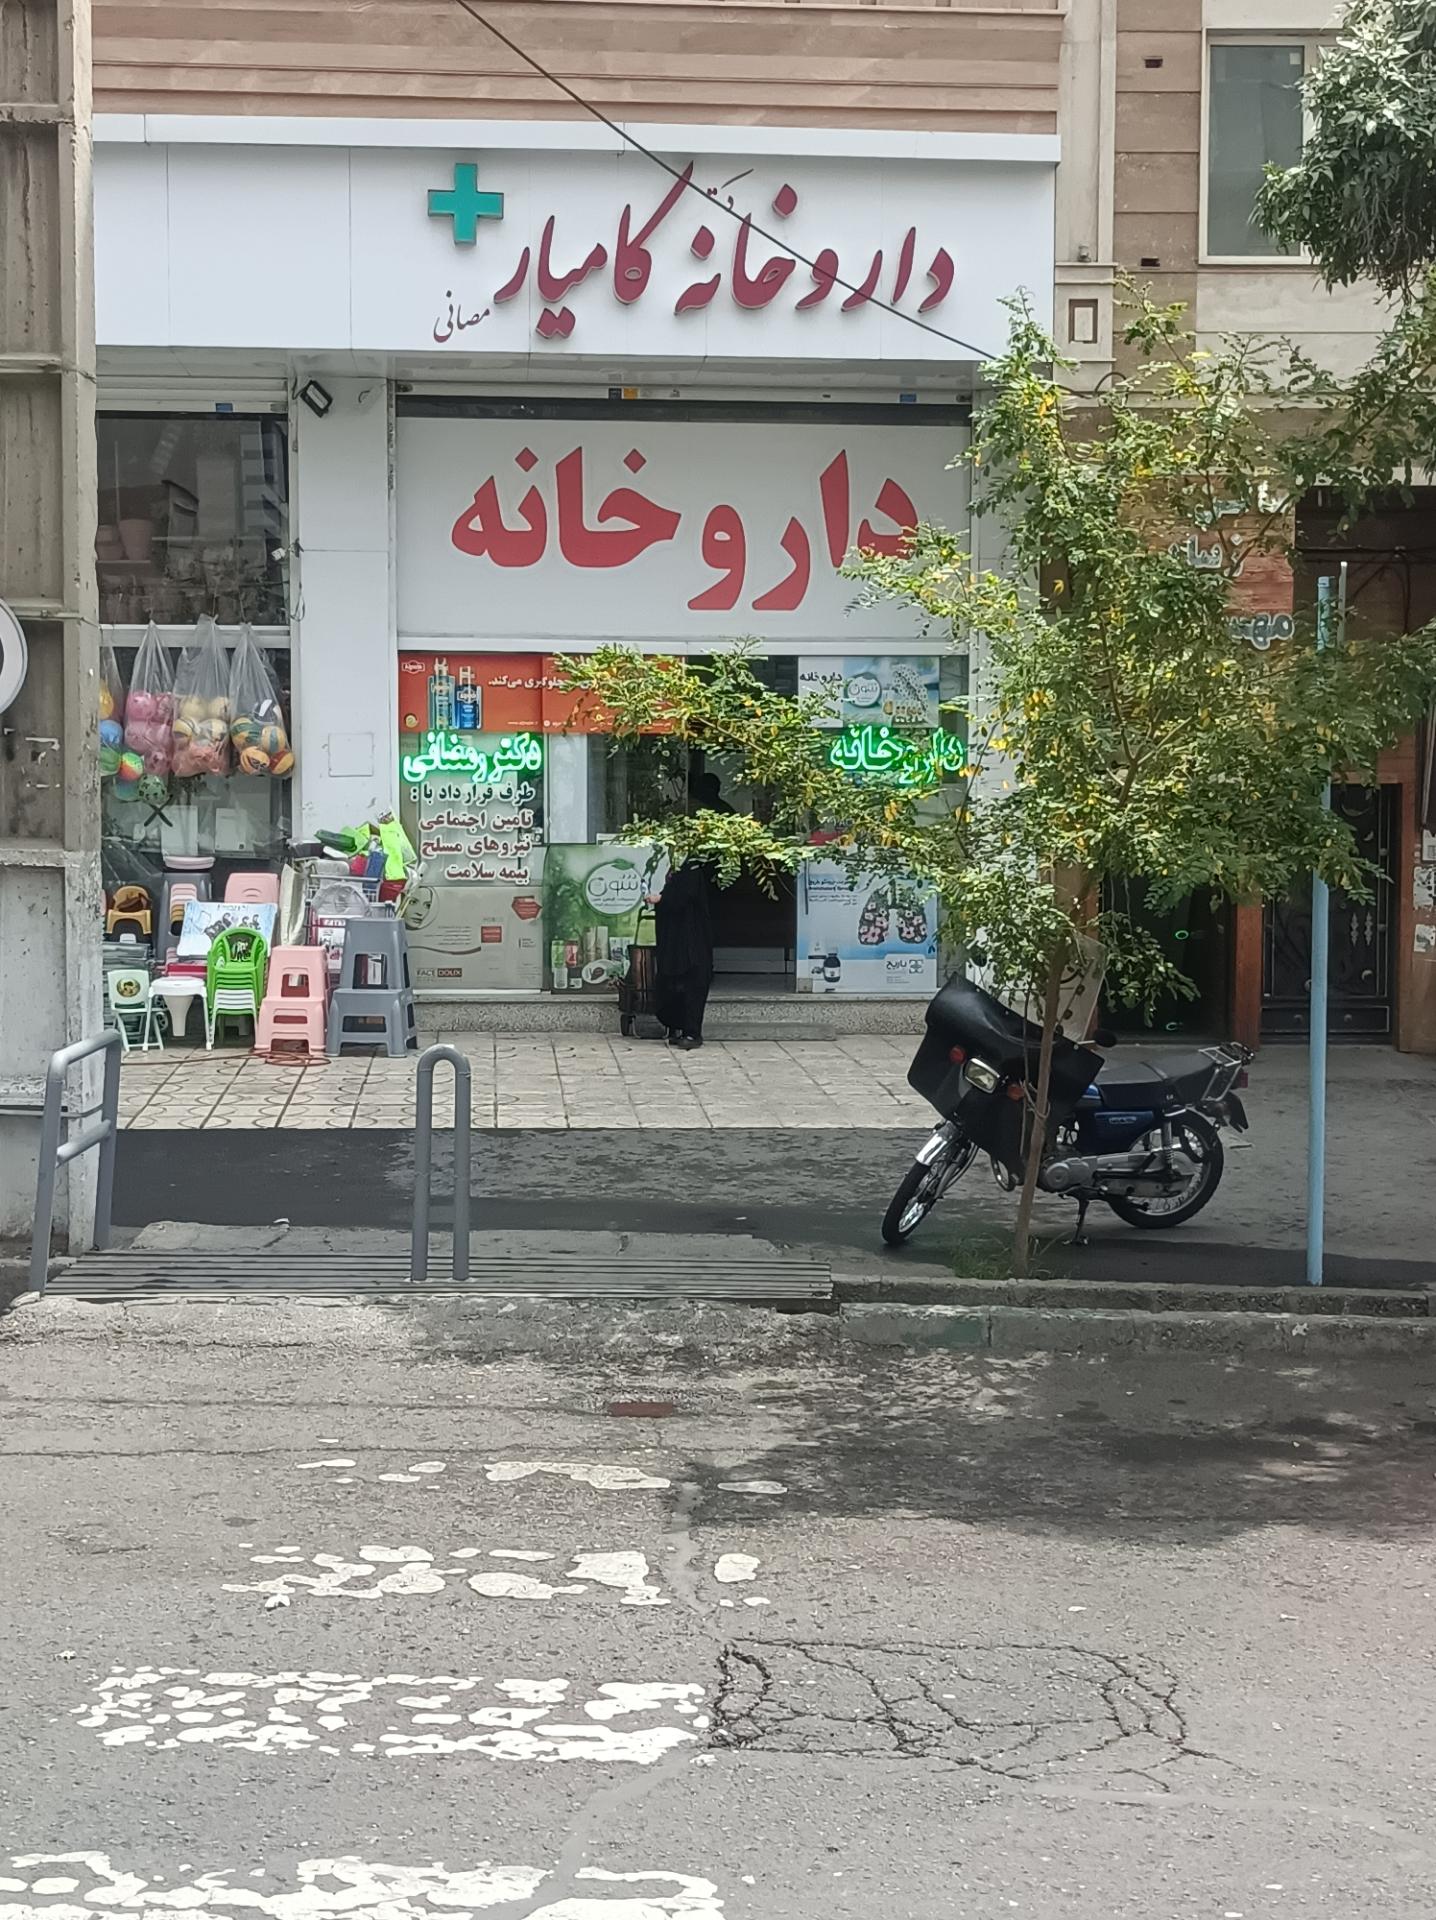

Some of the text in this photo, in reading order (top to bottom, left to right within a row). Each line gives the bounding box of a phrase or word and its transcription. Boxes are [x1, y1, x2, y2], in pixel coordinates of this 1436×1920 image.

[493, 160, 956, 339] داروخانه کامیار
[451, 446, 919, 611] داروخانه
[488, 732, 541, 783] دکتر
[830, 725, 963, 784] داروخانه
[500, 782, 534, 804] طرف
[420, 810, 533, 833] تامین اجتماعی
[421, 835, 530, 856] نیروهای مسلح
[446, 862, 528, 883] بیمه سلامت
